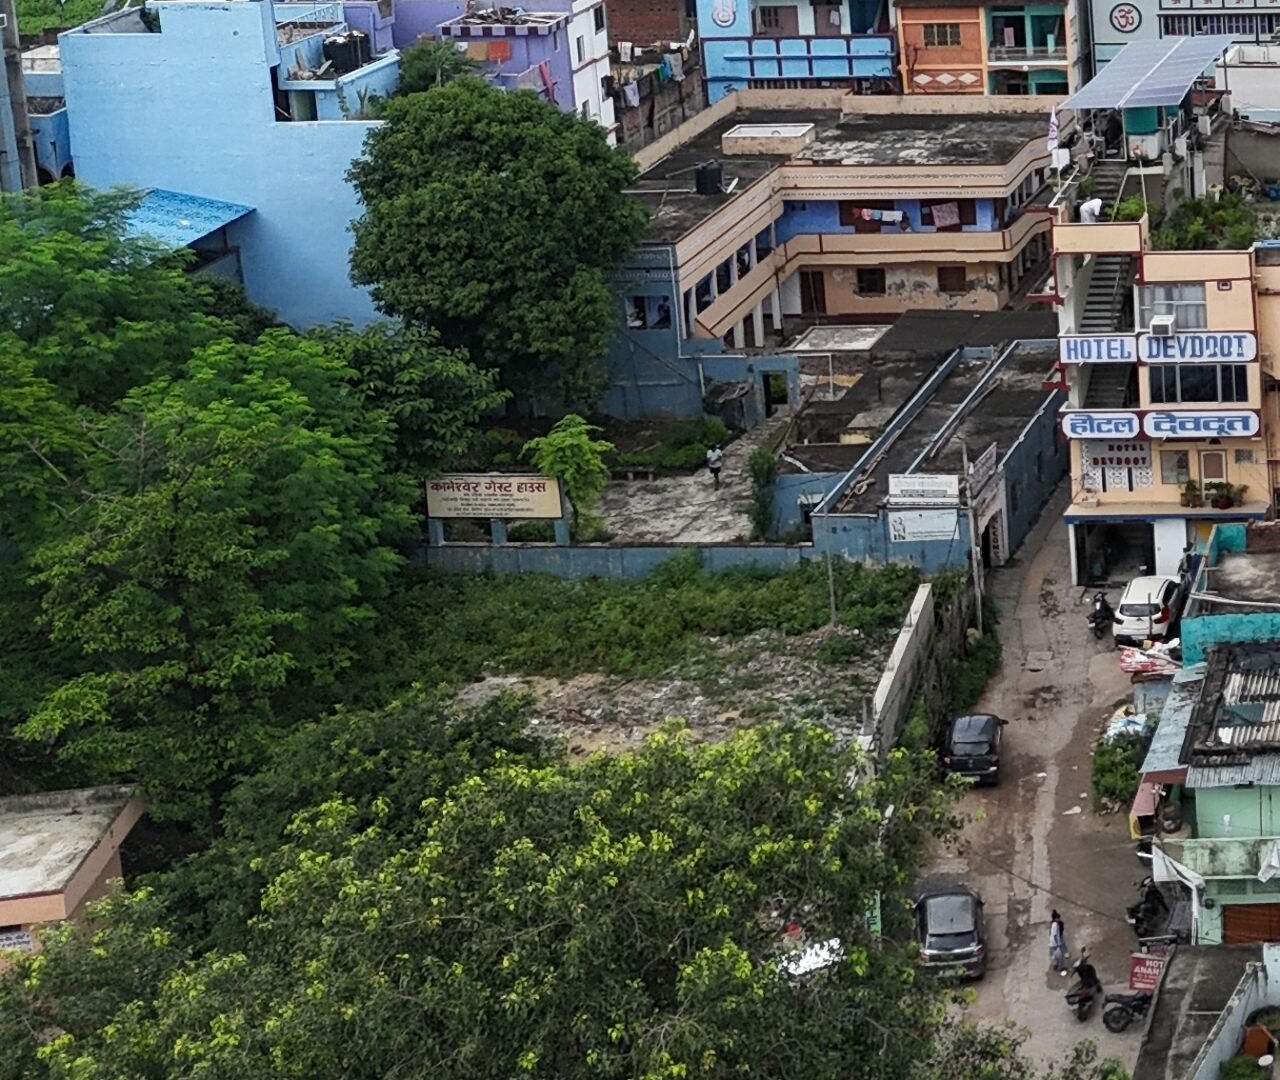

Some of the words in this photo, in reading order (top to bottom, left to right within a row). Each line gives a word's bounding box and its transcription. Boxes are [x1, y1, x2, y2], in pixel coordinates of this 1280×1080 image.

[1066, 338, 1132, 360] HOTEL
[1146, 335, 1247, 359] DEVDOOT
[1069, 412, 1135, 435] होटल
[1152, 412, 1252, 436] देवदूत
[1107, 444, 1145, 452] HOTEL
[1092, 457, 1147, 466] DEVDOOT
[484, 479, 513, 493] गेस्ट
[516, 481, 547, 494] हाउस
